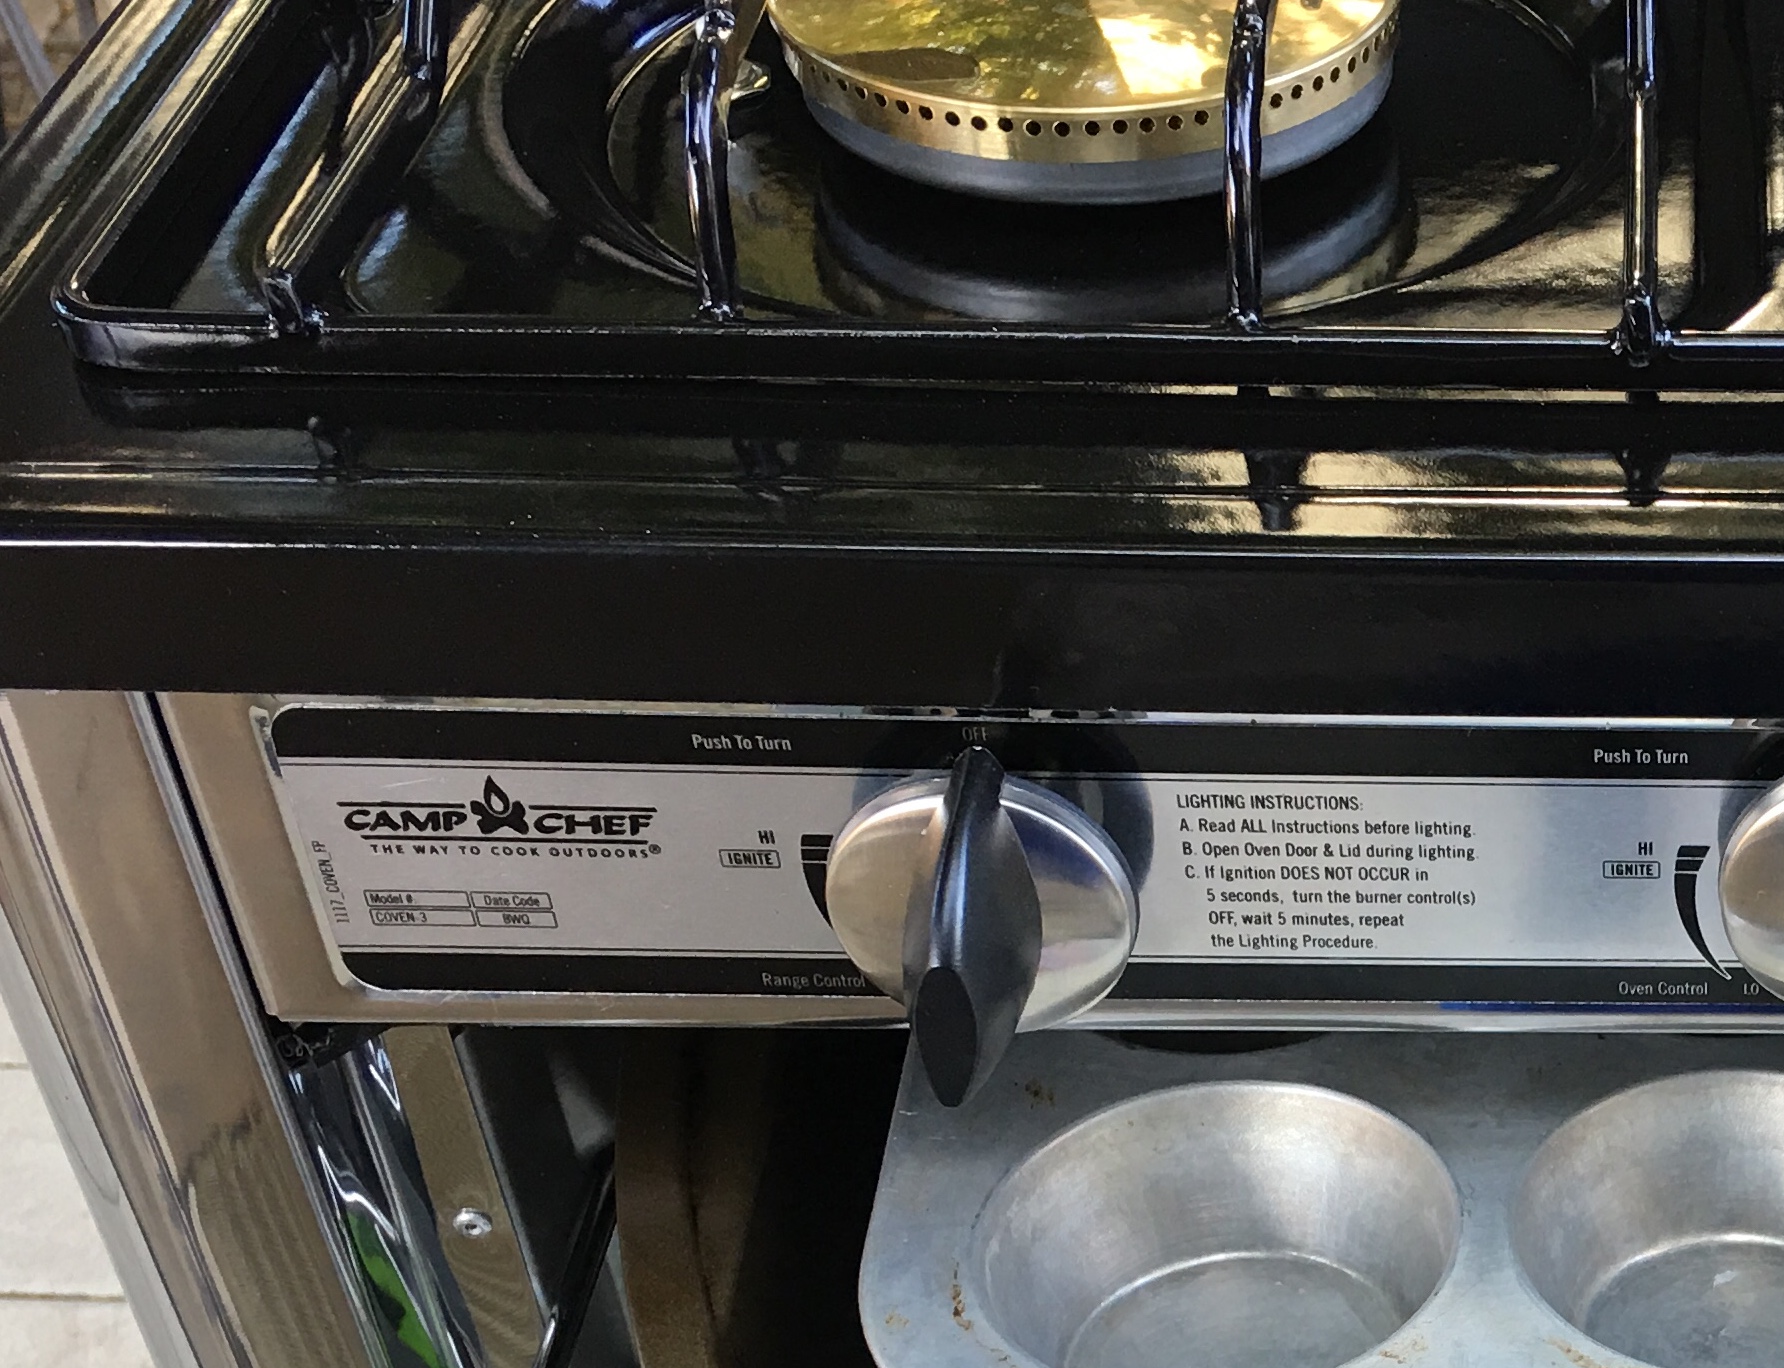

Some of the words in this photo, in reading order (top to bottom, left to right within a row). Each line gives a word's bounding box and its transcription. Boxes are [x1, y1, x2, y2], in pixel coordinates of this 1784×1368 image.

[962, 727, 989, 741] OFF
[692, 734, 732, 750] Push
[734, 735, 752, 749] To
[755, 735, 792, 751] Turn
[1594, 749, 1631, 764] Push
[1634, 749, 1651, 764] To
[1656, 749, 1689, 765] Turn
[1176, 794, 1246, 809] LIGHTING
[1251, 795, 1364, 811] INSTRUCTIONS:
[344, 809, 468, 832] CAMP
[533, 813, 653, 835] CHEF
[1199, 818, 1236, 833] Read
[1241, 819, 1267, 834] ALL
[1272, 819, 1359, 835] Instructions
[1364, 820, 1410, 835] before
[1415, 821, 1476, 838] lighting.
[758, 830, 775, 845] HI
[371, 844, 403, 855] THE
[415, 844, 449, 855] WAY
[459, 845, 481, 856] TO
[491, 846, 540, 857] COOK
[1202, 842, 1239, 859] Open
[1244, 842, 1281, 857] Oven
[1285, 843, 1318, 858] Door
[1323, 843, 1334, 858] &
[1339, 843, 1361, 858] Lid
[1366, 843, 1414, 861] during
[1418, 844, 1479, 862] lighting.
[1638, 841, 1653, 855] HI
[728, 852, 774, 866] IGNITE
[1204, 865, 1216, 879] If
[1221, 865, 1275, 882] Ignition
[1281, 866, 1320, 881] DOES
[1324, 866, 1353, 881] NOT
[1358, 867, 1410, 882] OCCUR
[1415, 867, 1429, 881] in
[1610, 864, 1654, 877] IGNITE
[370, 892, 403, 905] Model
[484, 895, 510, 907] Date
[513, 896, 541, 908] Code
[1206, 888, 1216, 902] 5
[1221, 888, 1284, 905] seconds,
[1292, 890, 1323, 904] turn
[1327, 889, 1351, 904] the
[1355, 890, 1402, 904] burner
[1407, 890, 1476, 906] control(s)
[376, 911, 415, 923] COVEN
[420, 911, 428, 923] 3
[1208, 911, 1237, 927] OFF,
[1241, 911, 1273, 926] wait
[1277, 911, 1287, 926] 5
[1291, 912, 1354, 928] minutes,
[1359, 913, 1404, 930] repeat
[1210, 933, 1235, 948] the
[1239, 934, 1298, 951] Lighting
[1303, 934, 1378, 949] Procedure.
[762, 973, 809, 988] Range
[813, 973, 866, 988] Control
[1619, 982, 1653, 996] Oven
[1658, 982, 1708, 996] Control
